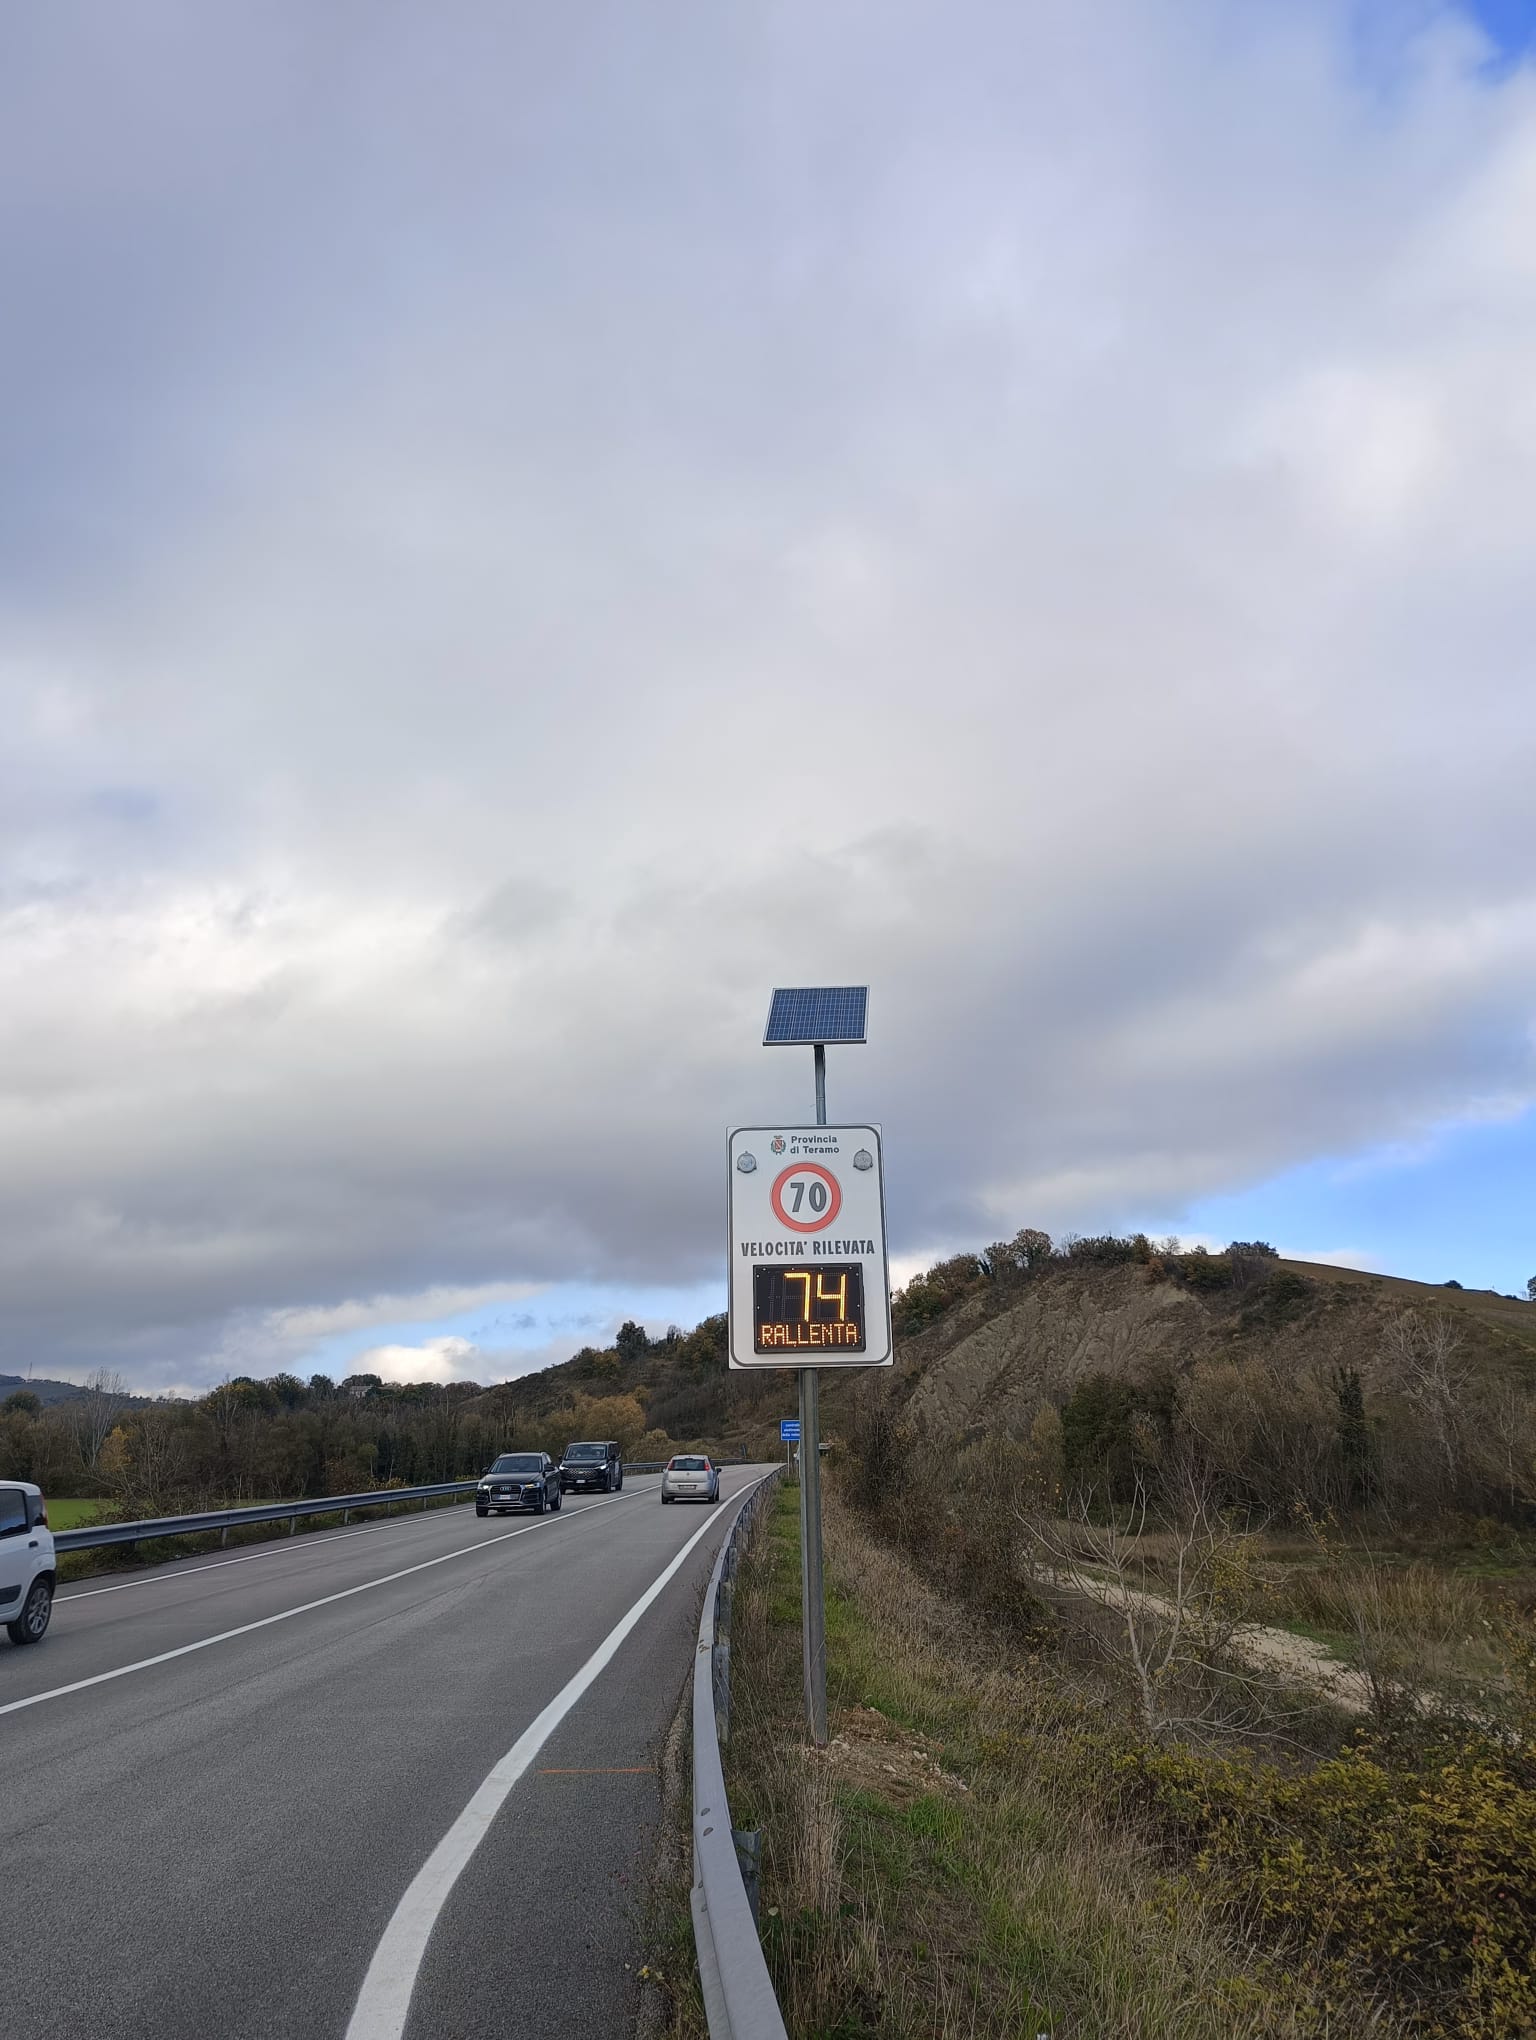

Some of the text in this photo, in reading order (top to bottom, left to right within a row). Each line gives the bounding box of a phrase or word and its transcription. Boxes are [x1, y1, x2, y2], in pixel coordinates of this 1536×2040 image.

[791, 1135, 838, 1144] Provincia
[790, 1145, 840, 1154] di Teramo
[790, 1181, 827, 1213] 70
[741, 1240, 875, 1257] VELOCITA' RILEVATA
[784, 1272, 847, 1322] 74
[761, 1323, 858, 1345] RALLENTA
